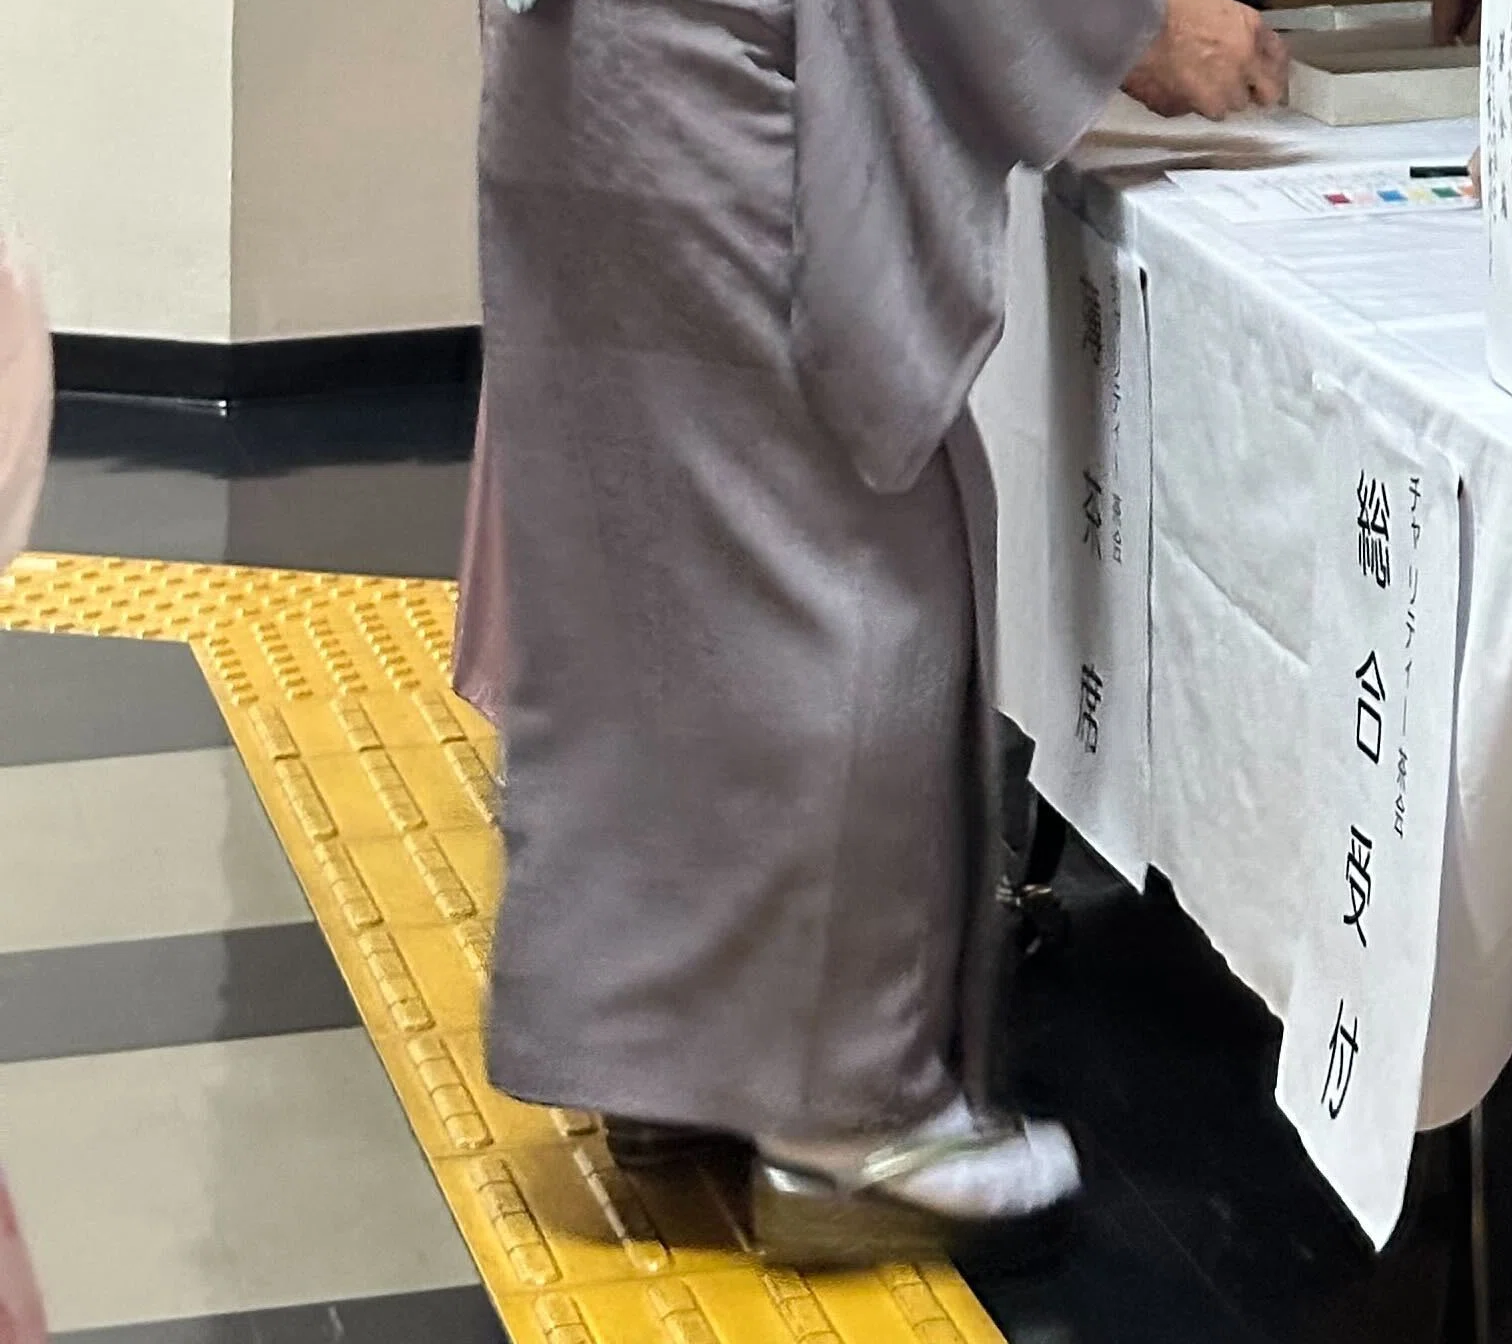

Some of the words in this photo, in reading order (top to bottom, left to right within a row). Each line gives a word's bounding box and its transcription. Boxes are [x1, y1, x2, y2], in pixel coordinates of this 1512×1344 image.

[1321, 468, 1391, 1122] 総合受付
[1394, 476, 1422, 839] チャリティー茶会
